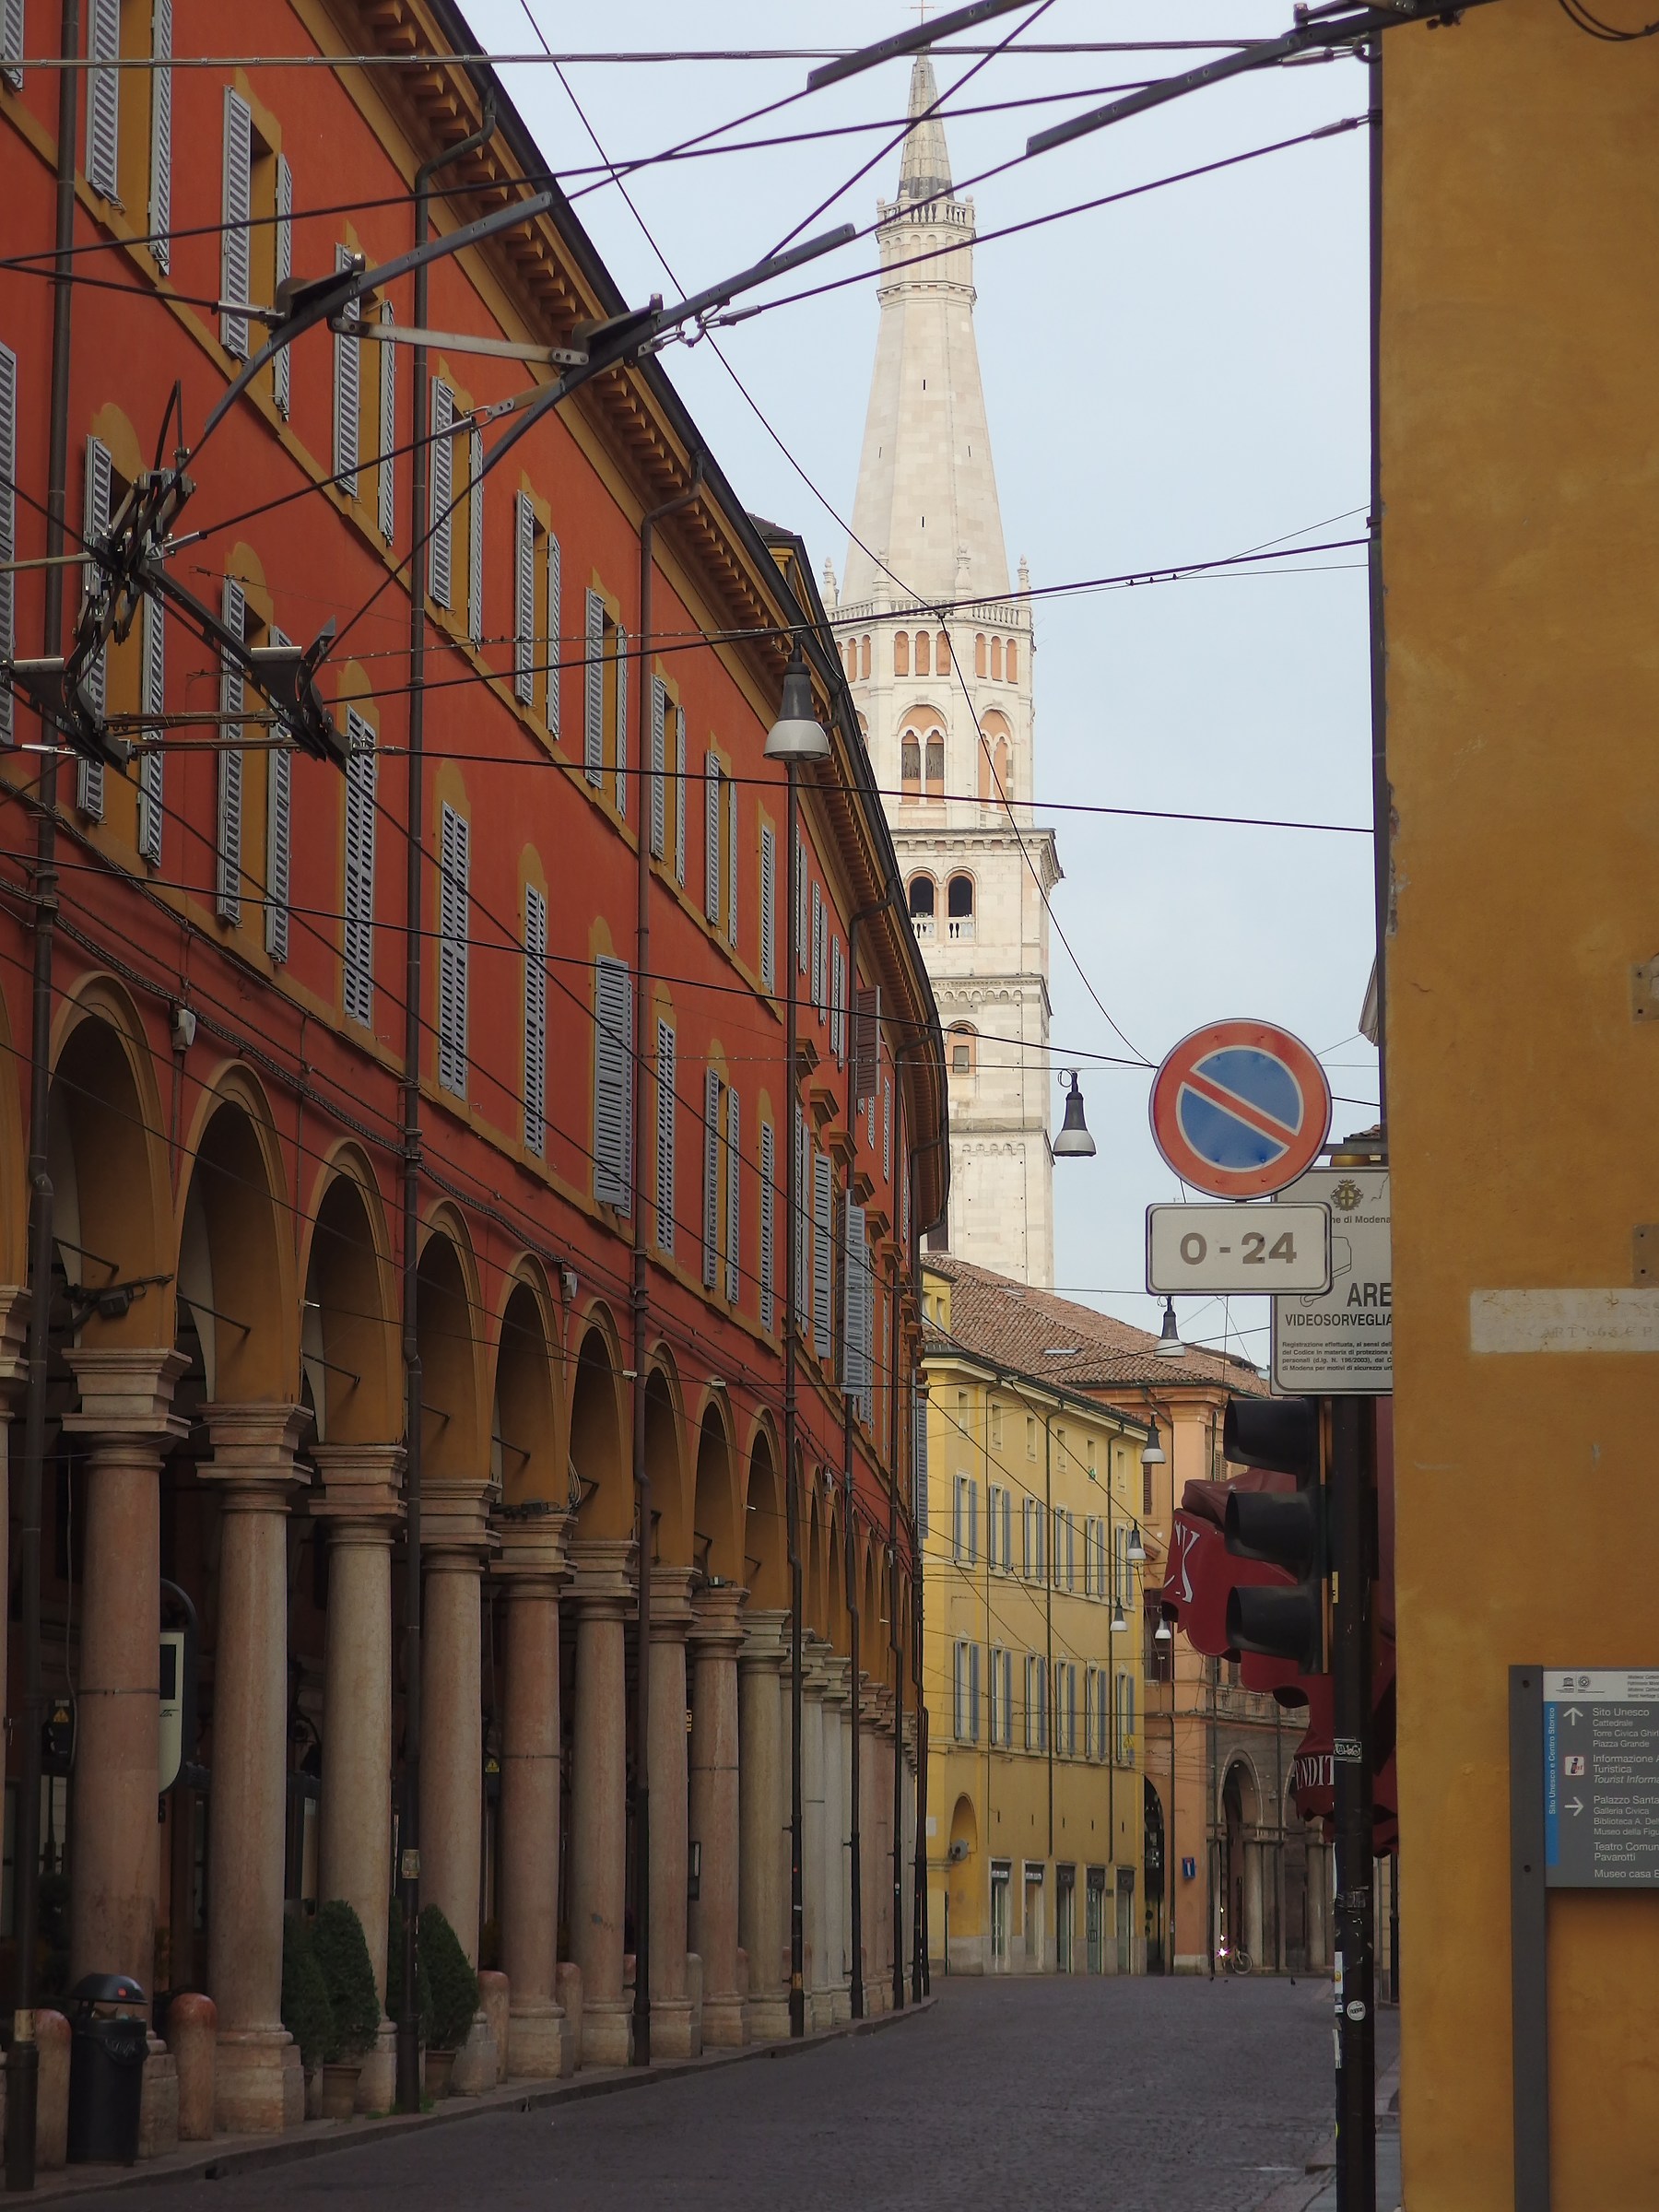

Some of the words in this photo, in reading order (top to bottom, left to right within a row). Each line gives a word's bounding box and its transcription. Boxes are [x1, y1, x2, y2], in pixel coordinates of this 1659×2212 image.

[1344, 1216, 1352, 1224] di
[1355, 1216, 1392, 1224] Modena
[1241, 1231, 1298, 1265] 24
[1347, 1282, 1392, 1307] ARE
[1592, 1707, 1611, 1717] Sito
[1614, 1708, 1650, 1717] Unesco
[1547, 1707, 1556, 1735] Storico
[1592, 1719, 1633, 1727] Cattedrale
[1593, 1729, 1613, 1737] Torre
[1614, 1729, 1639, 1737] Civica
[1593, 1754, 1653, 1763] Informazione
[1593, 1764, 1632, 1773] Turistica
[1594, 1774, 1624, 1783] Tourist
[1594, 1795, 1630, 1805] Palazzo
[1632, 1795, 1659, 1805] Santa
[1593, 1806, 1623, 1815] Galleria
[1625, 1806, 1650, 1815] Civica
[1594, 1817, 1632, 1825] Biblioteca
[1634, 1817, 1642, 1825] A.
[1594, 1828, 1620, 1836] Museo
[1622, 1828, 1641, 1836] della
[1594, 1841, 1623, 1851] Teatro
[1594, 1853, 1636, 1862] Pavarotti
[1594, 1869, 1627, 1878] Museo
